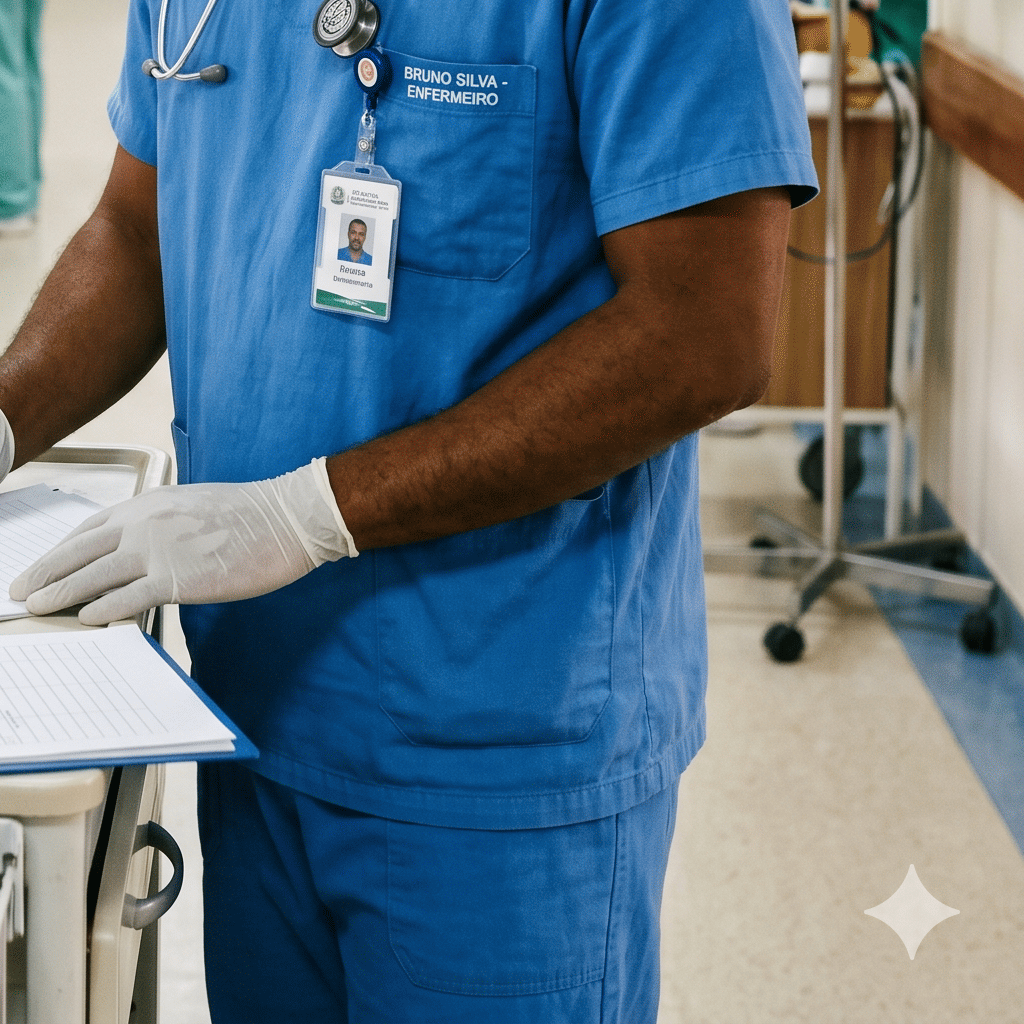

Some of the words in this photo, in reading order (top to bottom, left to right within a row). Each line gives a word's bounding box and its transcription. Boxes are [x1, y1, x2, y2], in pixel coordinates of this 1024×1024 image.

[404, 66, 452, 86] BRUNO
[456, 73, 499, 89] SILVA
[407, 85, 499, 106] ENFERMEIRO
